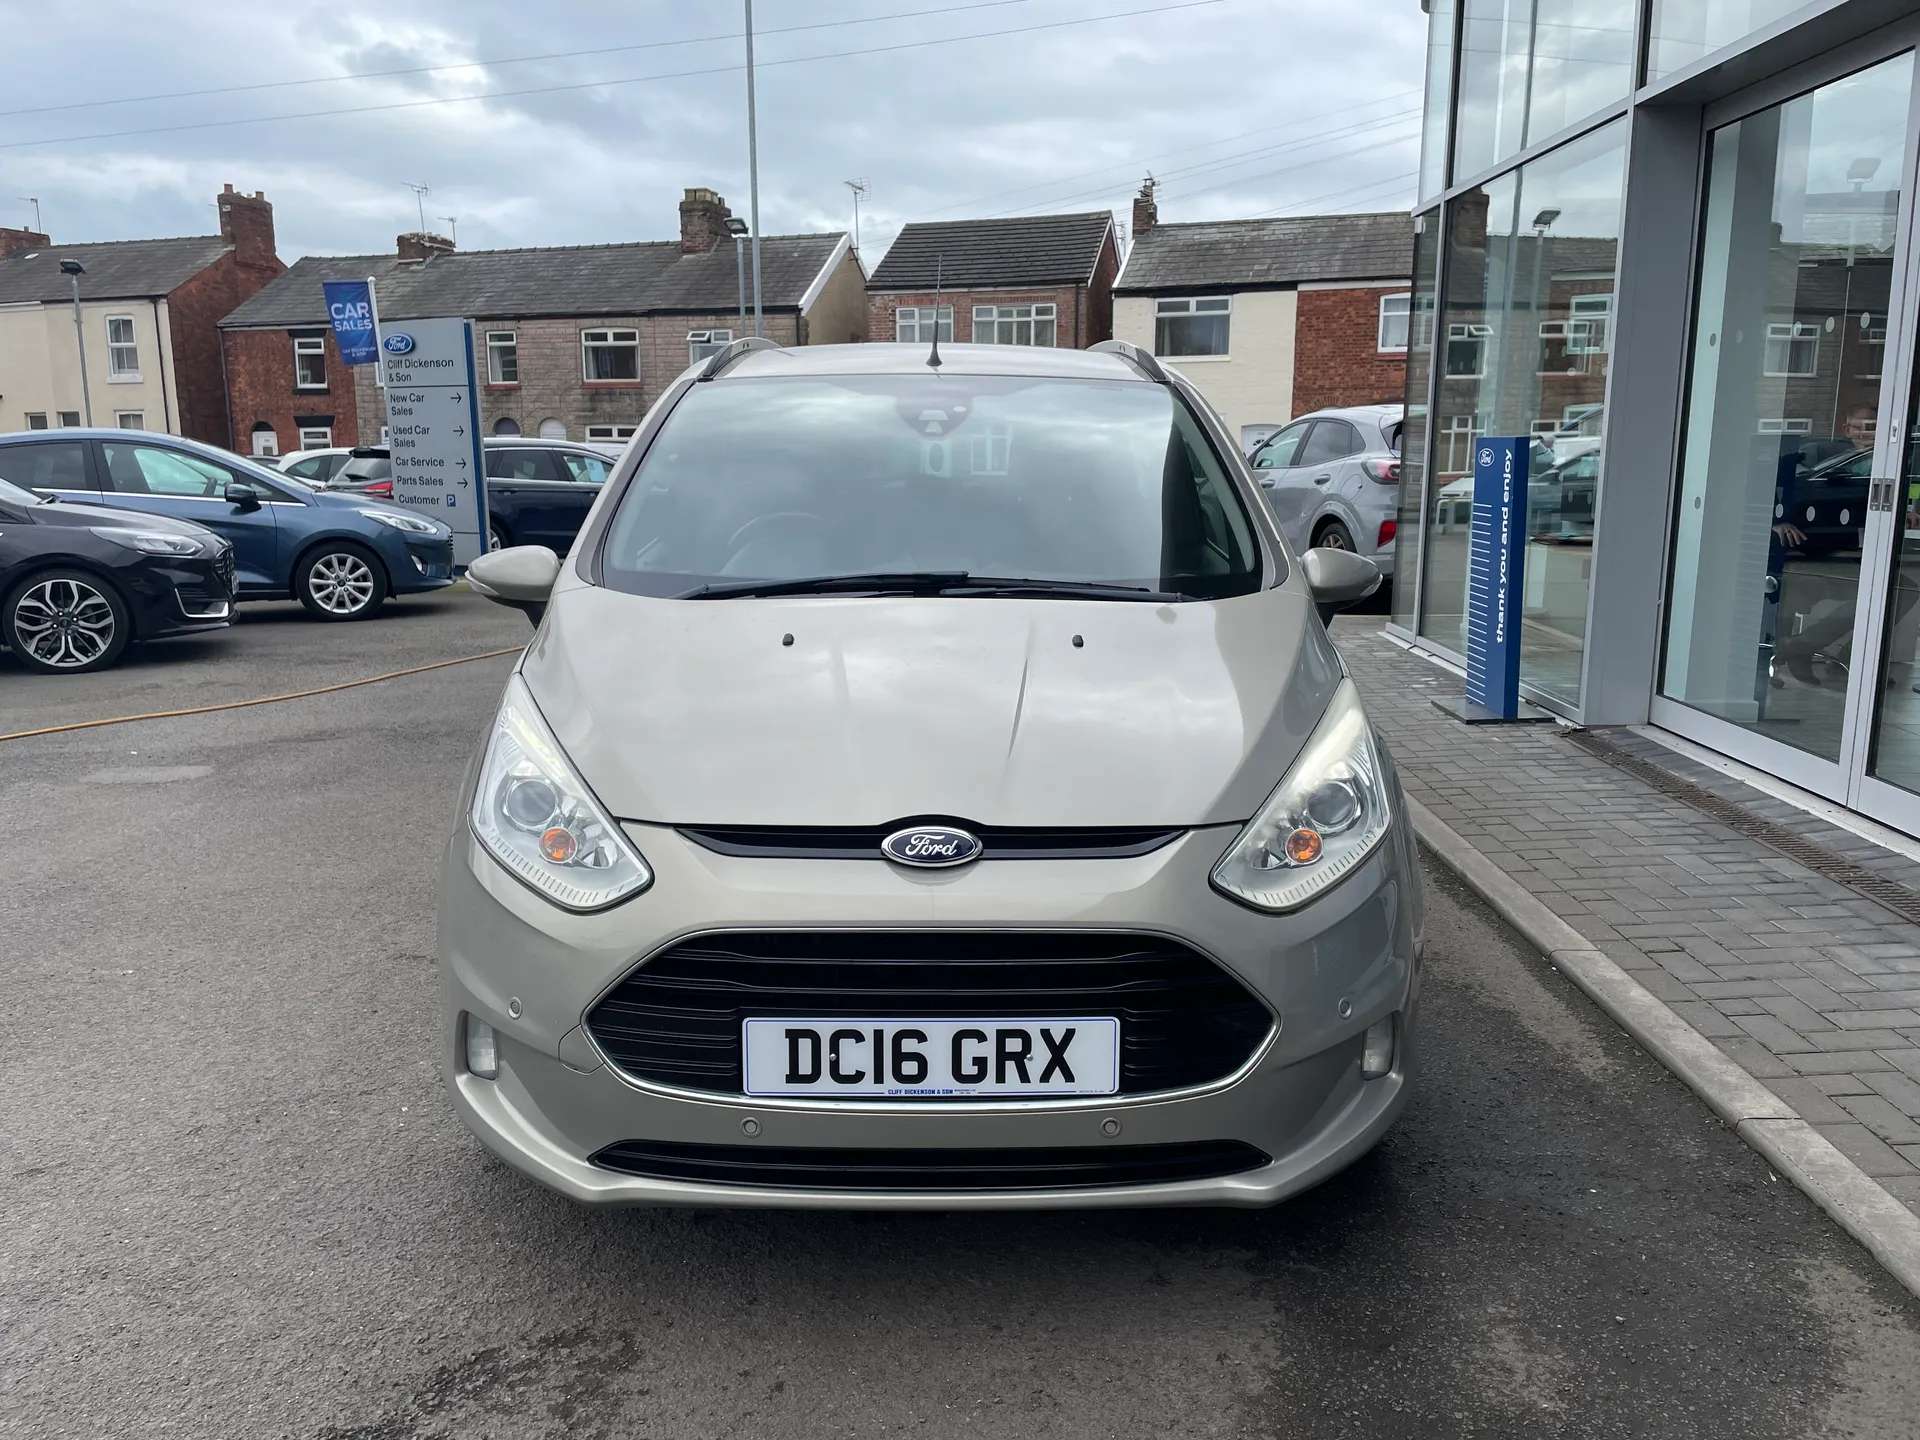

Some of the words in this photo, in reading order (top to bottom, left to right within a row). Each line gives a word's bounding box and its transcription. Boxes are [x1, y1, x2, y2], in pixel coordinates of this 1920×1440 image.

[331, 302, 370, 319] CAR
[334, 319, 373, 332] SALES
[388, 336, 407, 351] Ford
[387, 359, 403, 370] Cliff
[404, 358, 454, 369] Dickenson
[388, 374, 394, 382] &
[395, 372, 412, 382] Son
[390, 394, 408, 404] New
[409, 392, 425, 403] Car
[391, 406, 414, 416] Sales
[393, 425, 413, 435] Used
[414, 425, 430, 435] Car
[394, 438, 416, 448] Sales
[395, 457, 409, 466] Car
[410, 457, 445, 467] Service
[397, 475, 417, 486] Parts
[418, 475, 444, 486] Sales
[1503, 448, 1512, 503] enjoy
[398, 494, 440, 505] Customer
[1501, 506, 1509, 545] and
[1496, 587, 1505, 643] thank
[905, 834, 958, 856] Ford
[785, 1028, 929, 1085] DC16
[951, 1028, 1077, 1084] GRX
